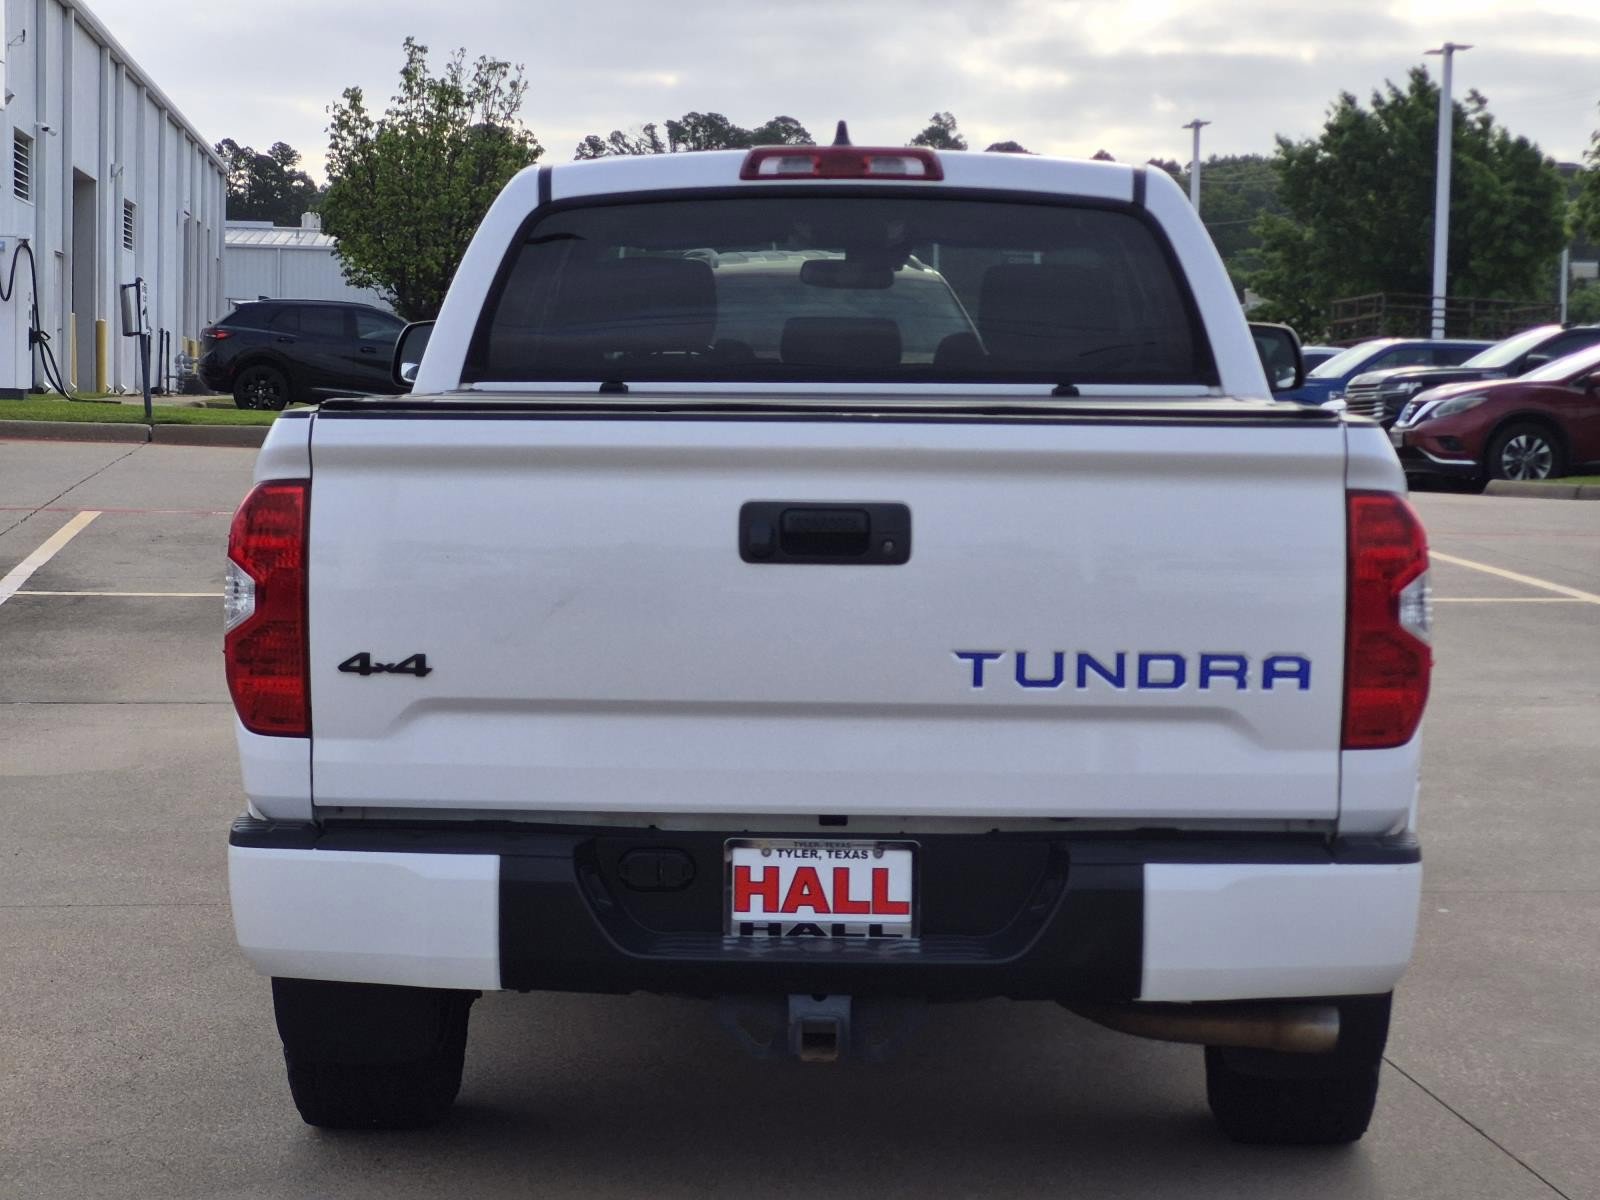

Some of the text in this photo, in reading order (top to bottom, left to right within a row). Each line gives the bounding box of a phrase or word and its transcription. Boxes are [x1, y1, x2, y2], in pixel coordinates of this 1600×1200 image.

[953, 650, 1311, 690] TUNDRA
[776, 849, 869, 860] TYLER, TEXAS
[734, 865, 910, 915] HALL
[740, 922, 903, 938] HALL
